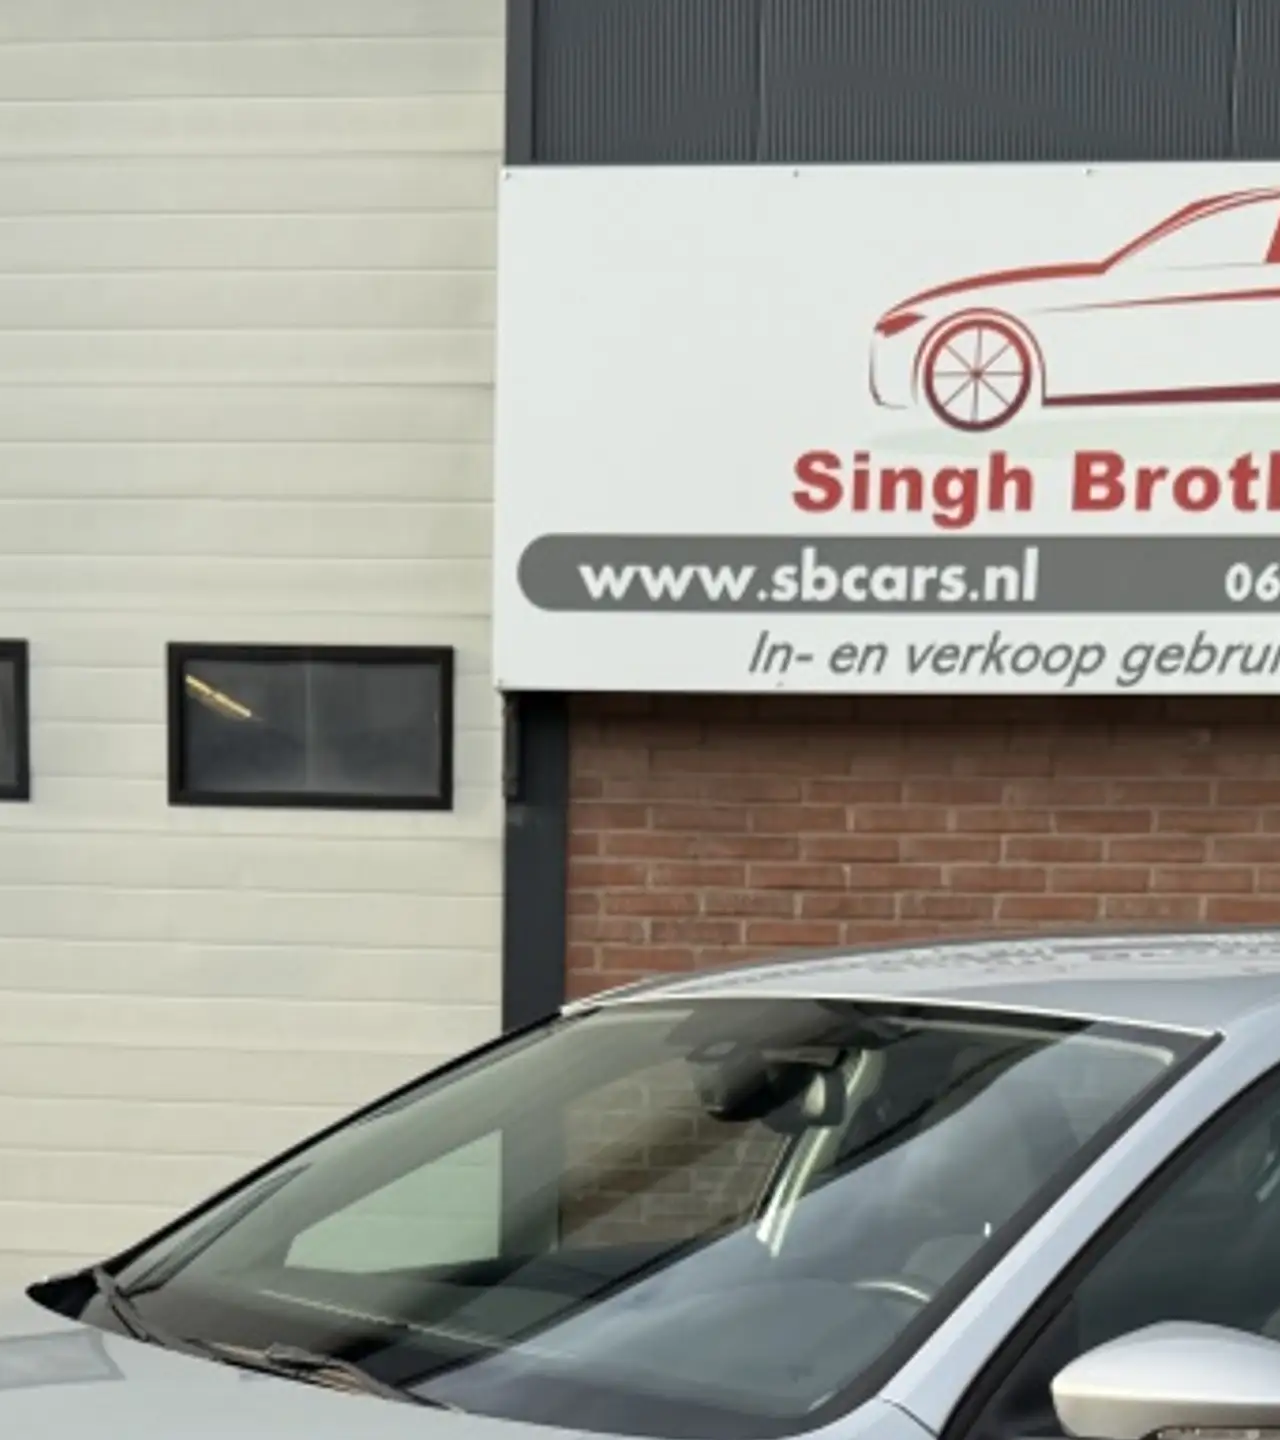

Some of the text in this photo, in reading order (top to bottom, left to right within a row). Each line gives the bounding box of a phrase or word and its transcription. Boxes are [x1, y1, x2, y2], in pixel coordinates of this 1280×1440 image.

[793, 451, 1033, 529] Singh
[578, 546, 1039, 604] www.sbcars.nl
[748, 630, 814, 676] In-
[829, 643, 888, 676] en
[907, 631, 1107, 688] verkoop
